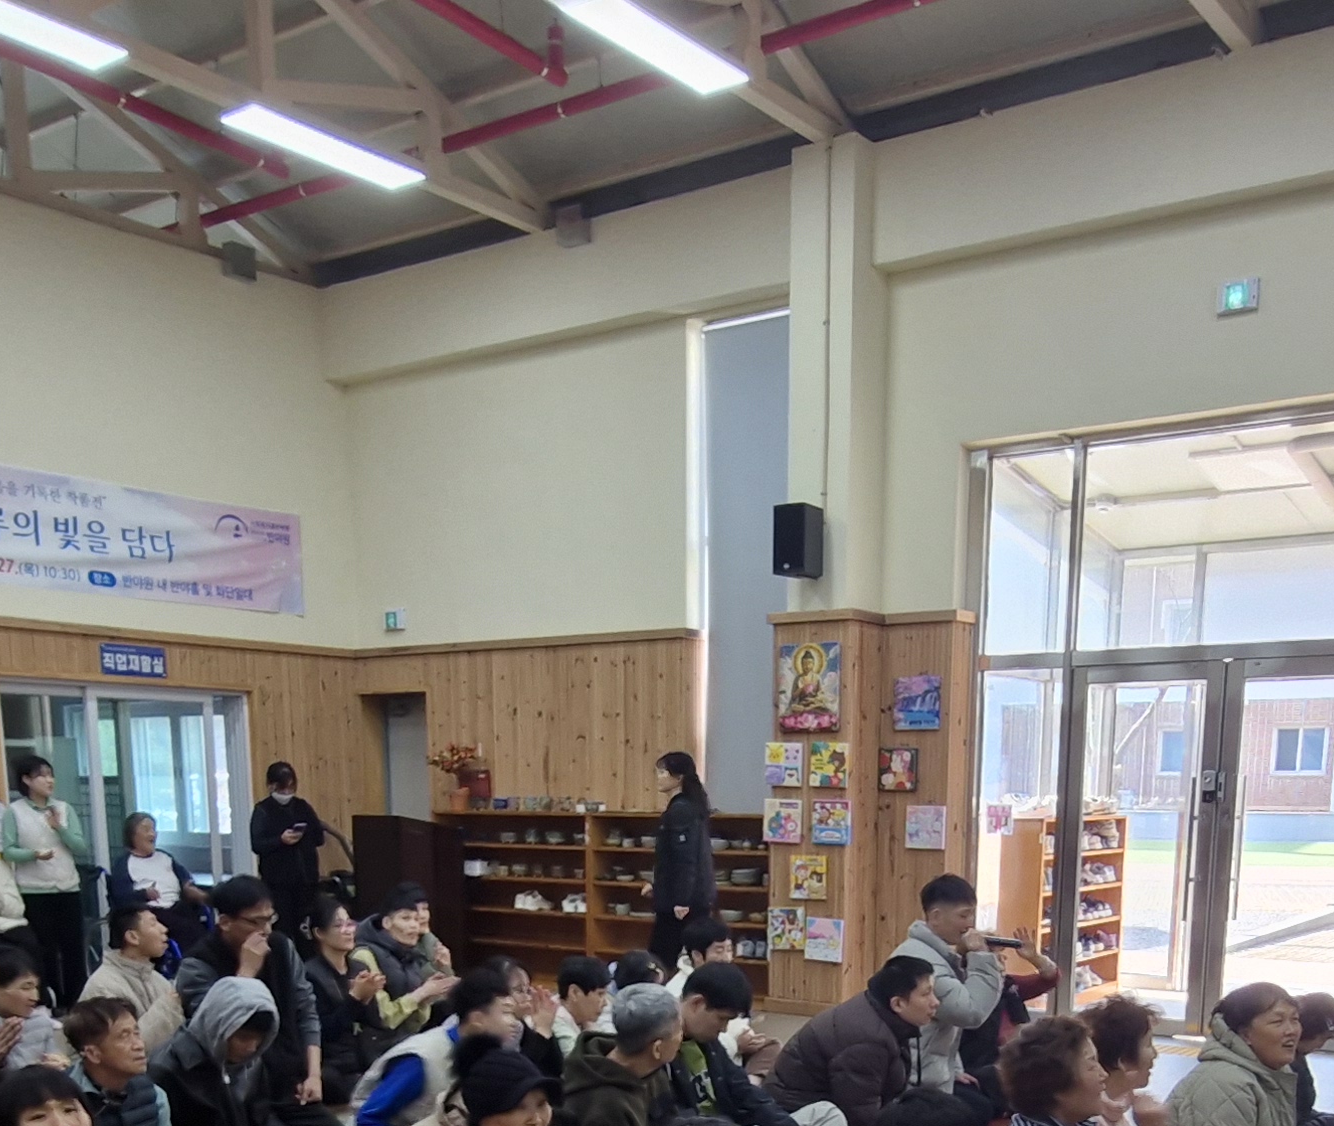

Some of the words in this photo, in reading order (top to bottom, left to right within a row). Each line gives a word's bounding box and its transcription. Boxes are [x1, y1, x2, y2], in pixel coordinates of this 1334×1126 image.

[52, 516, 111, 556] 빛을
[120, 525, 176, 563] 담다
[102, 651, 165, 674] 직업재활실
